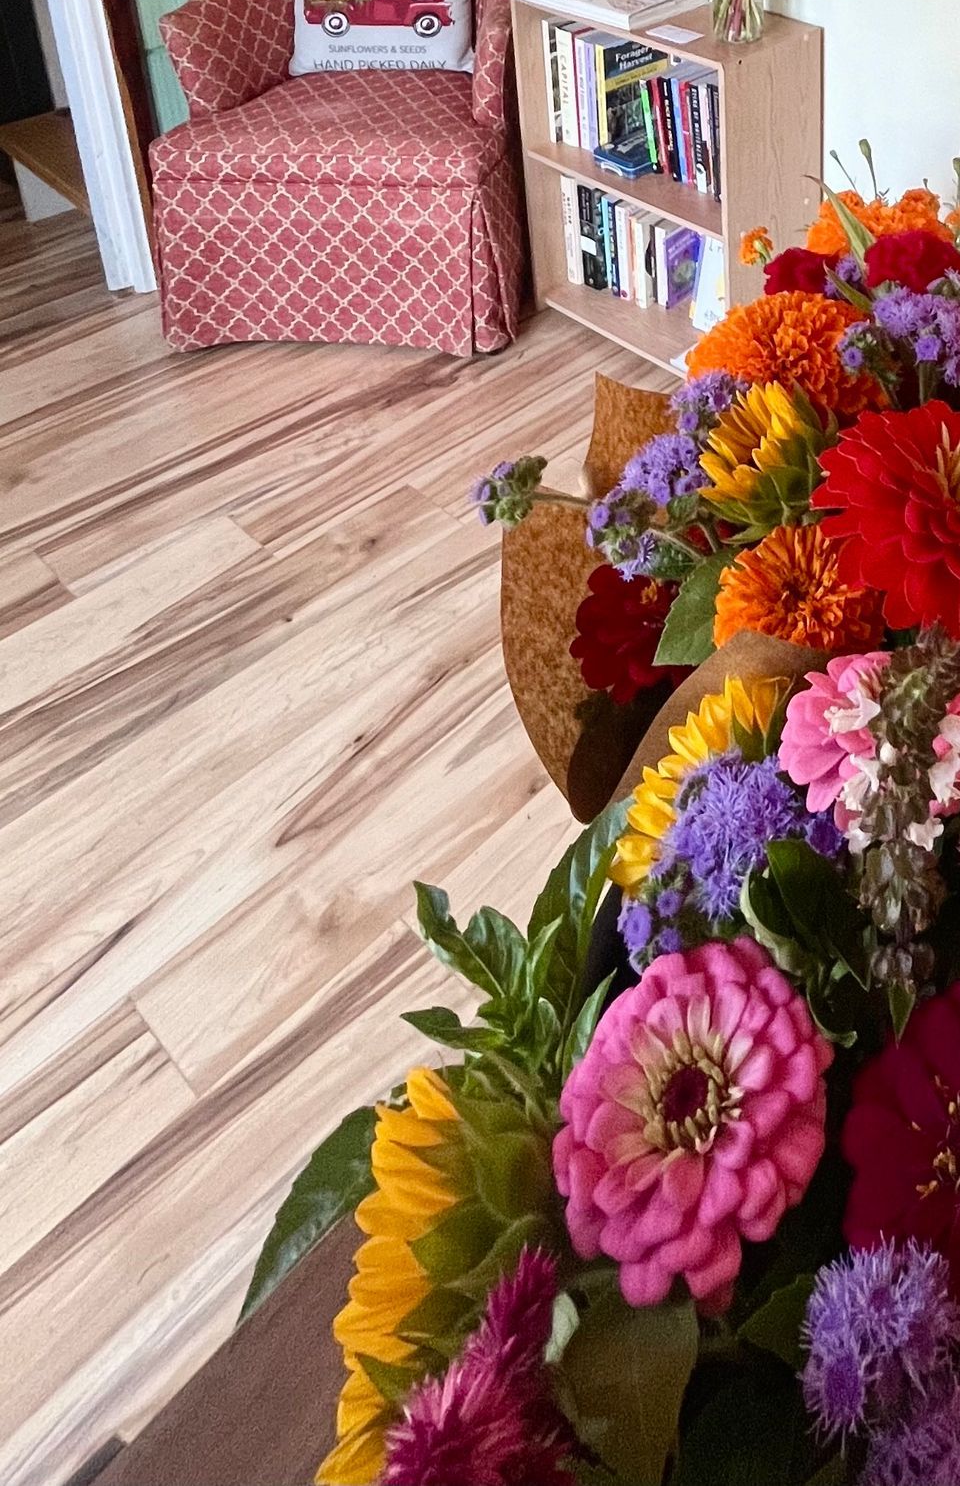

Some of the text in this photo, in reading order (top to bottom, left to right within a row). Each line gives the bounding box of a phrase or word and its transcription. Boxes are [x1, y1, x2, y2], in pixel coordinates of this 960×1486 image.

[328, 44, 427, 54] SUNFLOWERS & SEEDS
[313, 59, 447, 70] HAND PICKED DAILY
[619, 53, 653, 71] Harvest
[560, 54, 569, 105] CAPITAL
